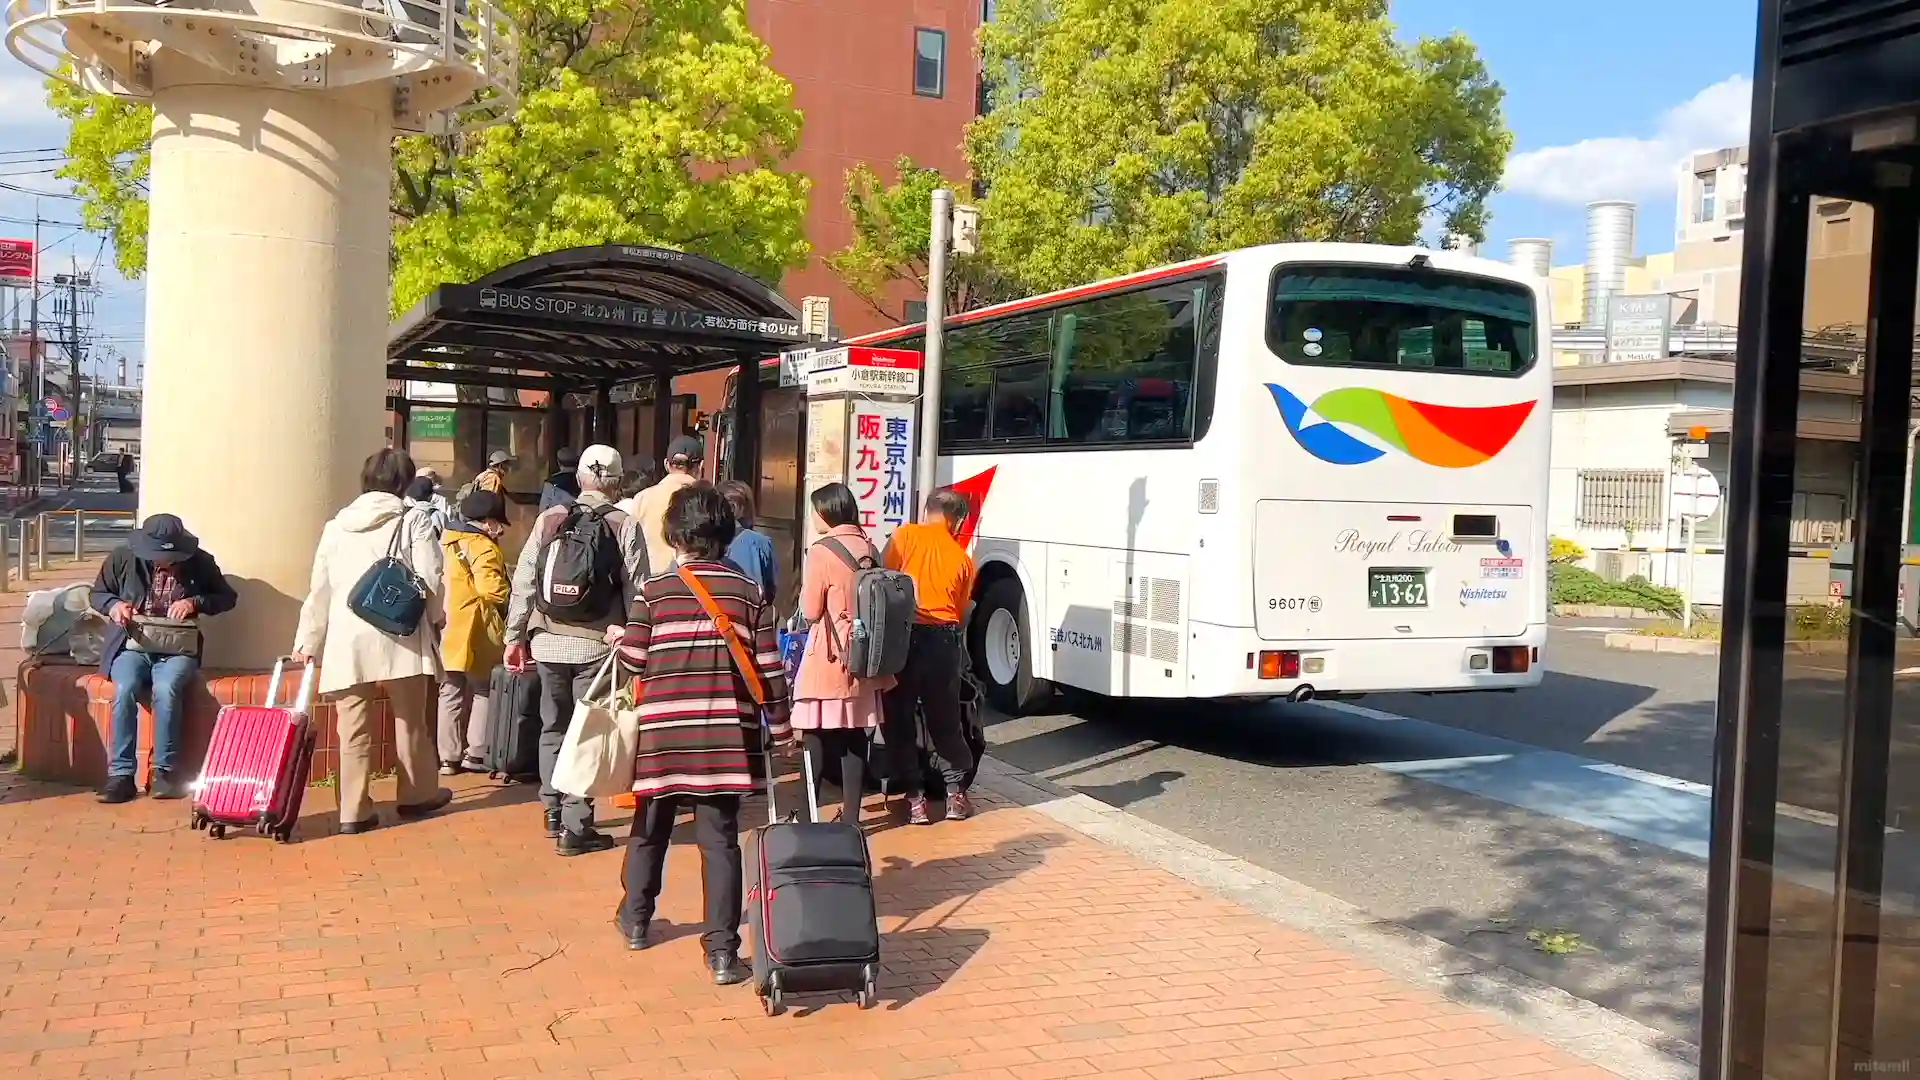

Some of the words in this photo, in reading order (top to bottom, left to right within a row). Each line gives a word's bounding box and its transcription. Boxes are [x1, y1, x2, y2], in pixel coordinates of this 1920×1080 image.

[499, 293, 531, 310] BUS
[535, 296, 577, 314] STOP
[704, 315, 799, 336] 若松方面行きのりば
[852, 369, 914, 384] 小倉駅新幹線口
[1334, 528, 1402, 561] Royal
[1407, 529, 1464, 553] Saloon
[555, 585, 577, 593] FILA
[1381, 583, 1426, 605] 13-62
[1460, 588, 1507, 599] Nishitetsu
[1269, 598, 1305, 610] 9607
